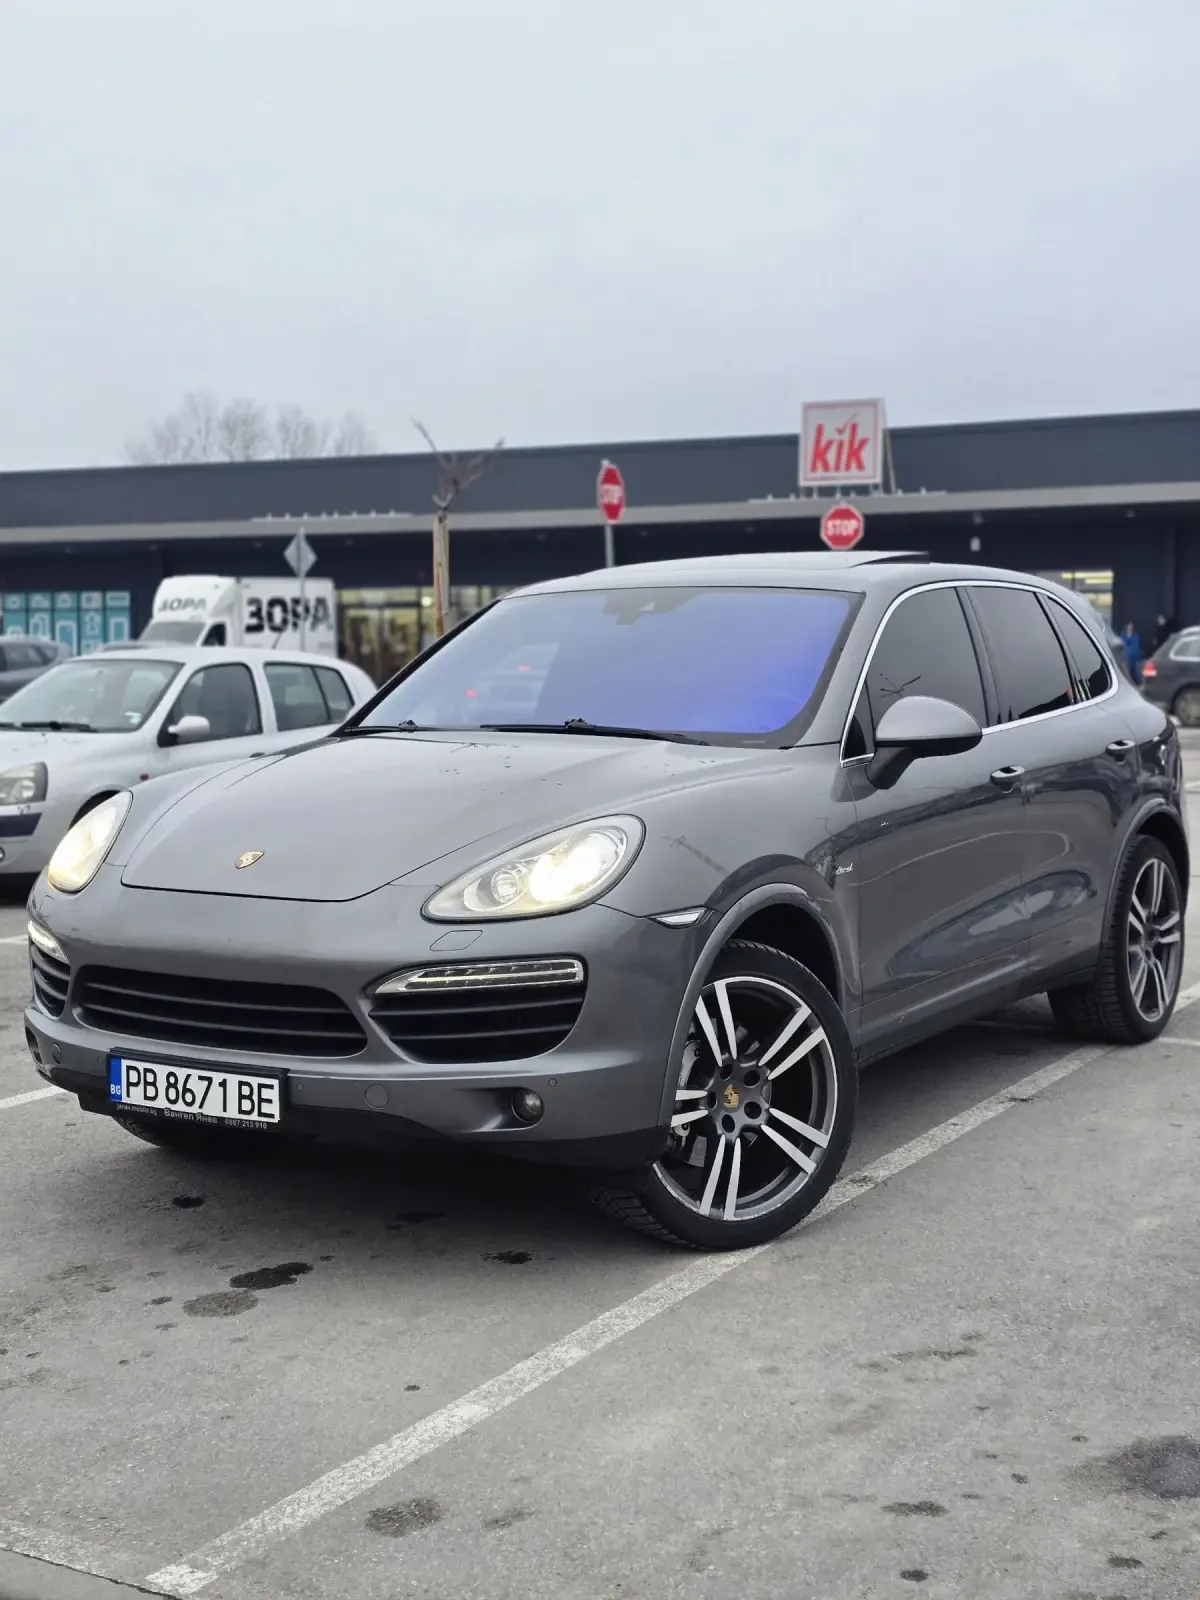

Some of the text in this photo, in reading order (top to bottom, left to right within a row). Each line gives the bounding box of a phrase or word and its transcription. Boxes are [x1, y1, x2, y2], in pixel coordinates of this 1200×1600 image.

[809, 415, 869, 473] kik
[826, 519, 859, 536] STOP
[110, 1084, 121, 1095] BG
[125, 1065, 275, 1119] PB 8671 BE
[196, 1113, 218, 1124] Янев
